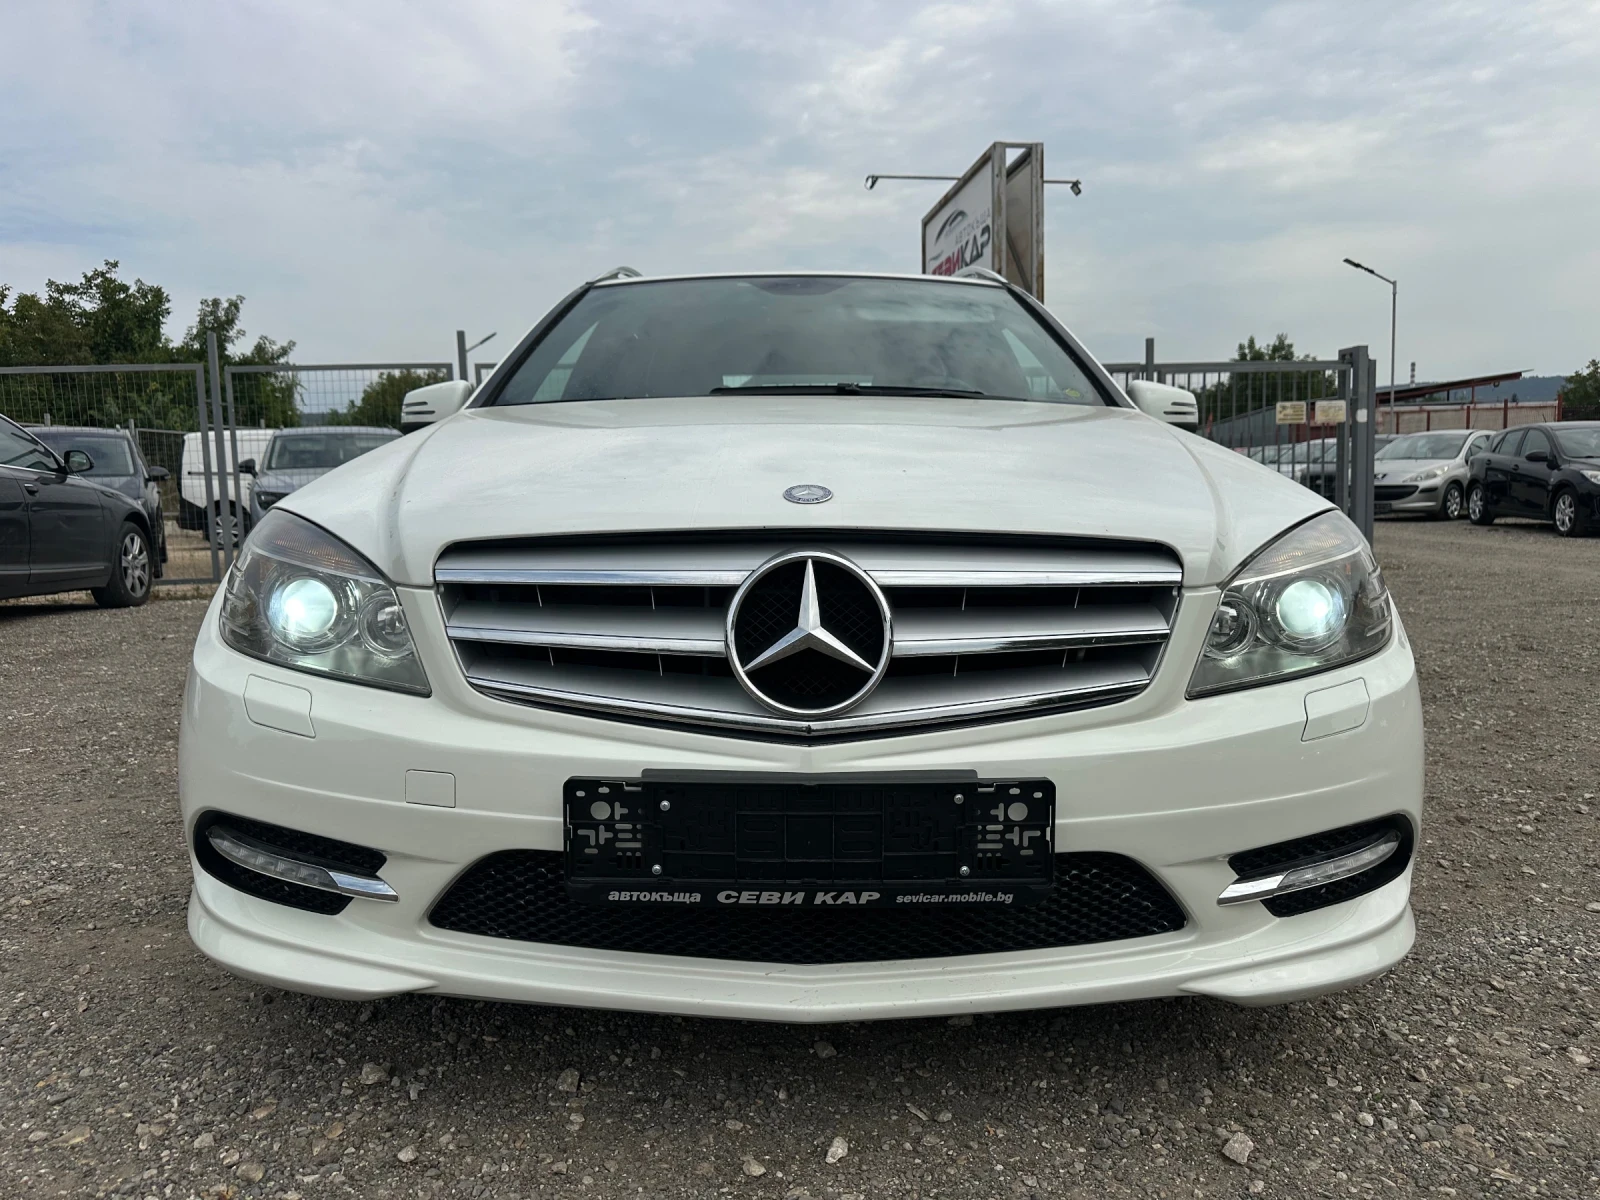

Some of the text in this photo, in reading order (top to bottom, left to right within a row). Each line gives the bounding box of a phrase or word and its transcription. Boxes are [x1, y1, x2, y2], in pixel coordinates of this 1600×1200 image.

[607, 890, 881, 905] автокъща СЕВИ КАР
[895, 891, 1014, 906] sevicar.mobile.bg
